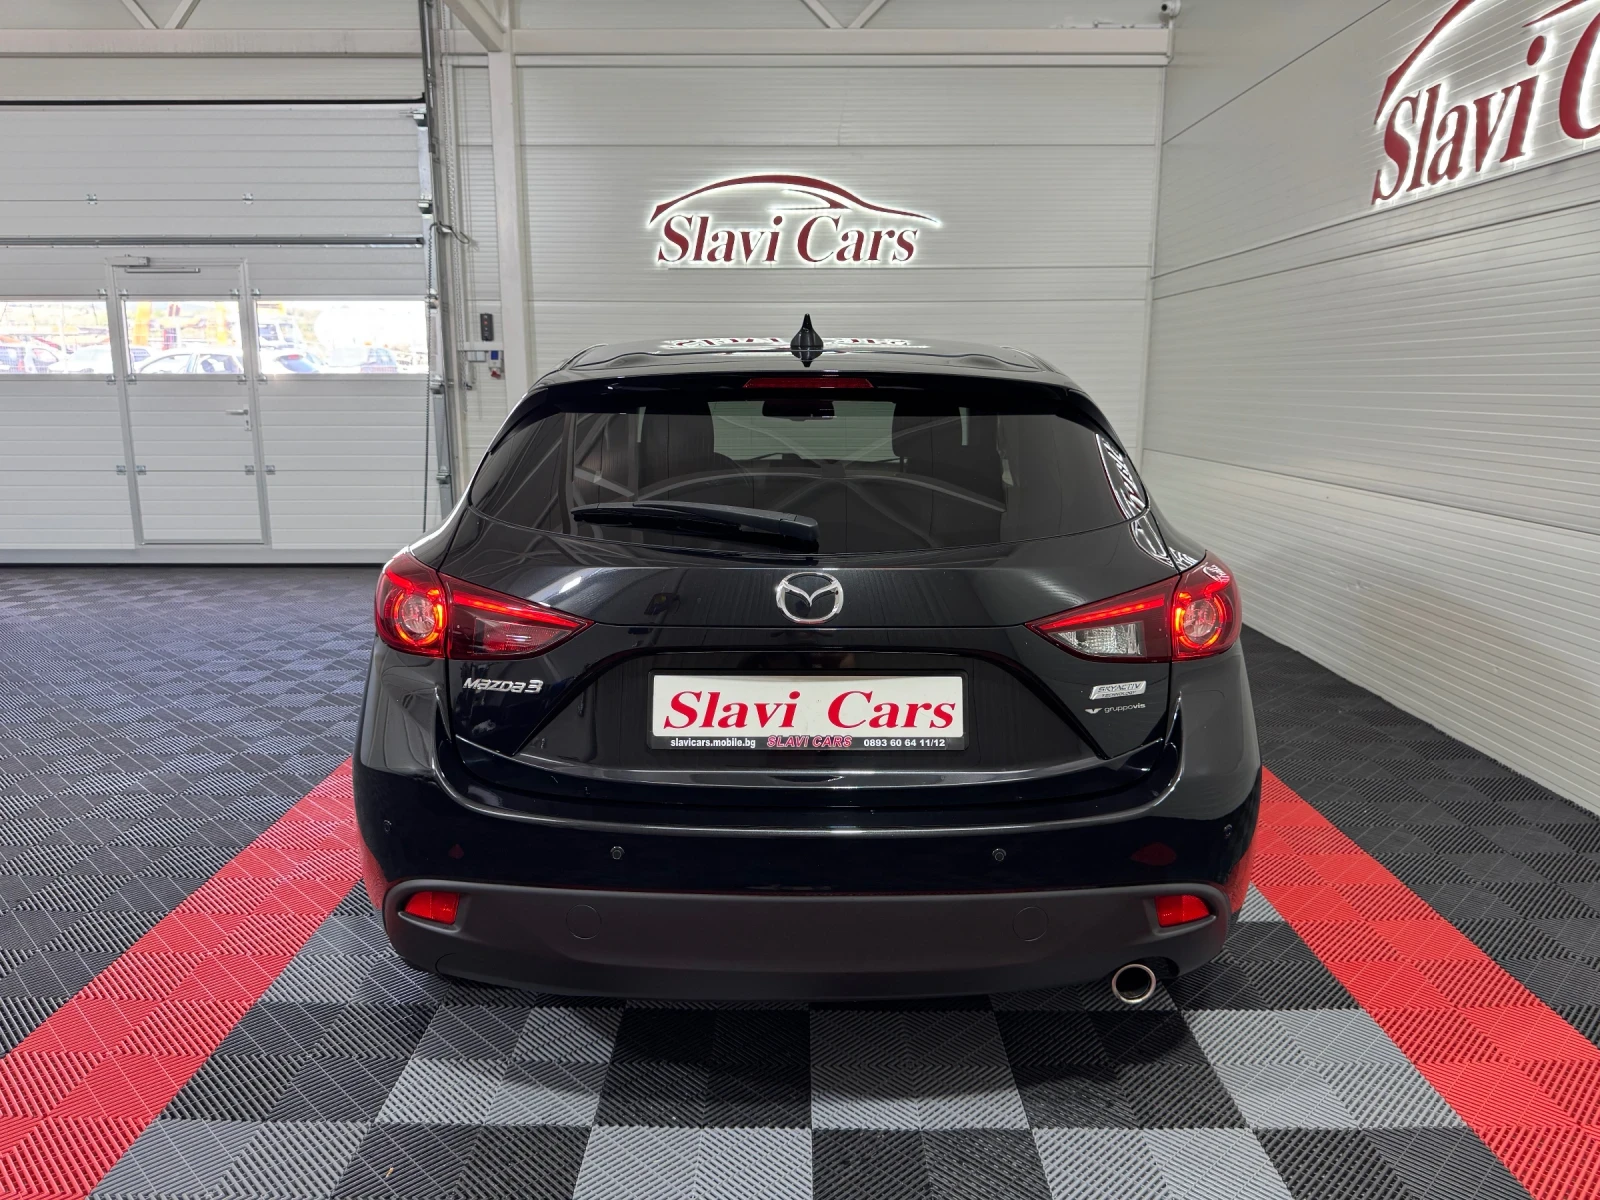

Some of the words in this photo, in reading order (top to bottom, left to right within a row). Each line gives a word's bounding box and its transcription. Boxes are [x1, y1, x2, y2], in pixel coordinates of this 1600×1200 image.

[1371, 35, 1547, 206] Slavi
[657, 214, 783, 263] Slavi
[797, 214, 918, 263] Cars
[1098, 682, 1142, 693] SKYACTIV
[663, 690, 801, 730] Slavi
[827, 690, 956, 729] Cars
[1104, 702, 1146, 714] gruppovis
[670, 737, 756, 749] slavicars.mobile.bg
[766, 735, 809, 748] SLAVI
[812, 735, 853, 748] CARS
[863, 738, 888, 747] 0893
[890, 738, 902, 747] 60
[904, 738, 917, 747] 64
[920, 738, 946, 747] 11/12
